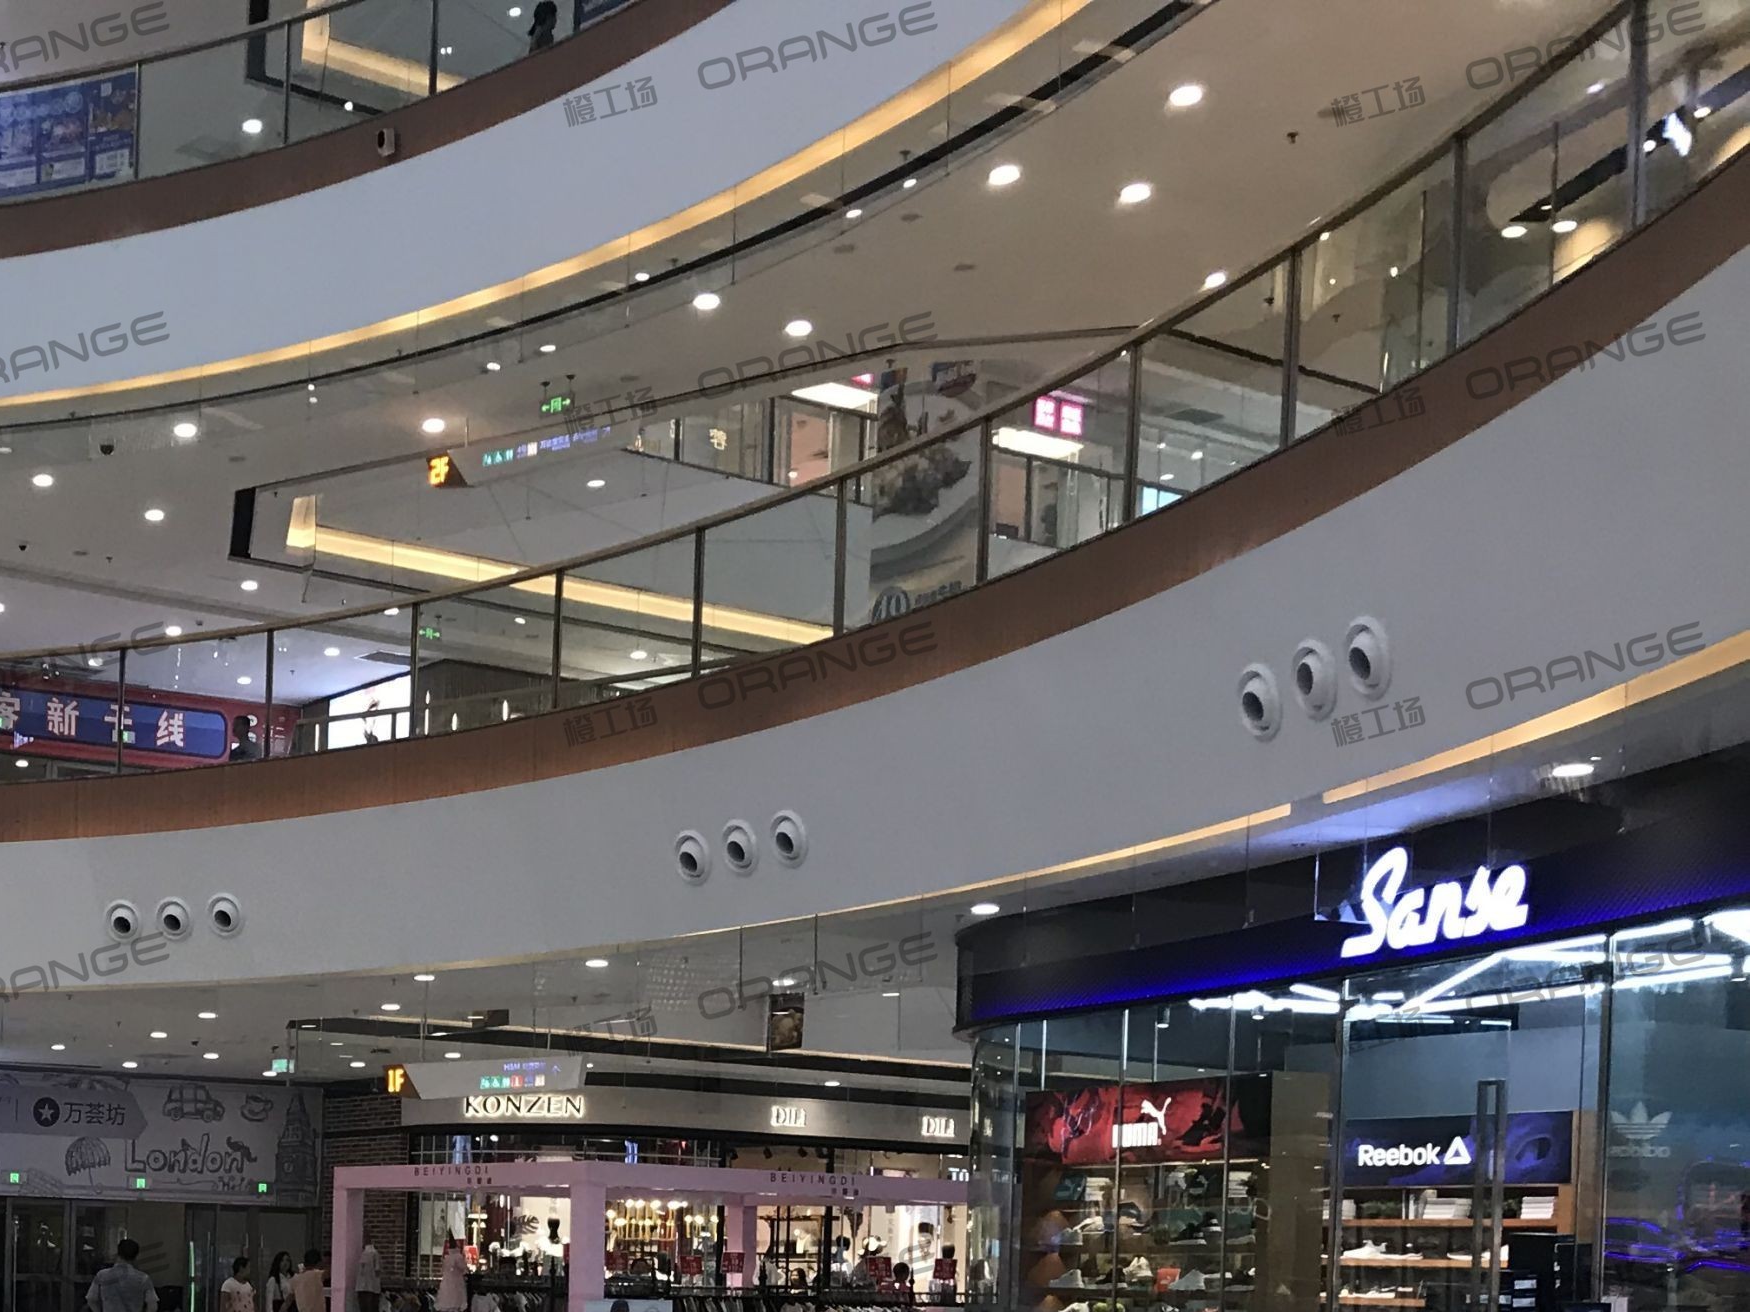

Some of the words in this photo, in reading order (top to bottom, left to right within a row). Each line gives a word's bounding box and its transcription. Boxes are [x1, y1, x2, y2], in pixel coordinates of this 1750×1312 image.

[63, 1102, 126, 1126] 万荟坊
[463, 1095, 585, 1117] KONZEN
[124, 1133, 246, 1174] London
[1357, 1142, 1441, 1167] Reebok
[414, 1165, 489, 1177] BEIYINGDI
[770, 1172, 855, 1185] BEIYINGDI
